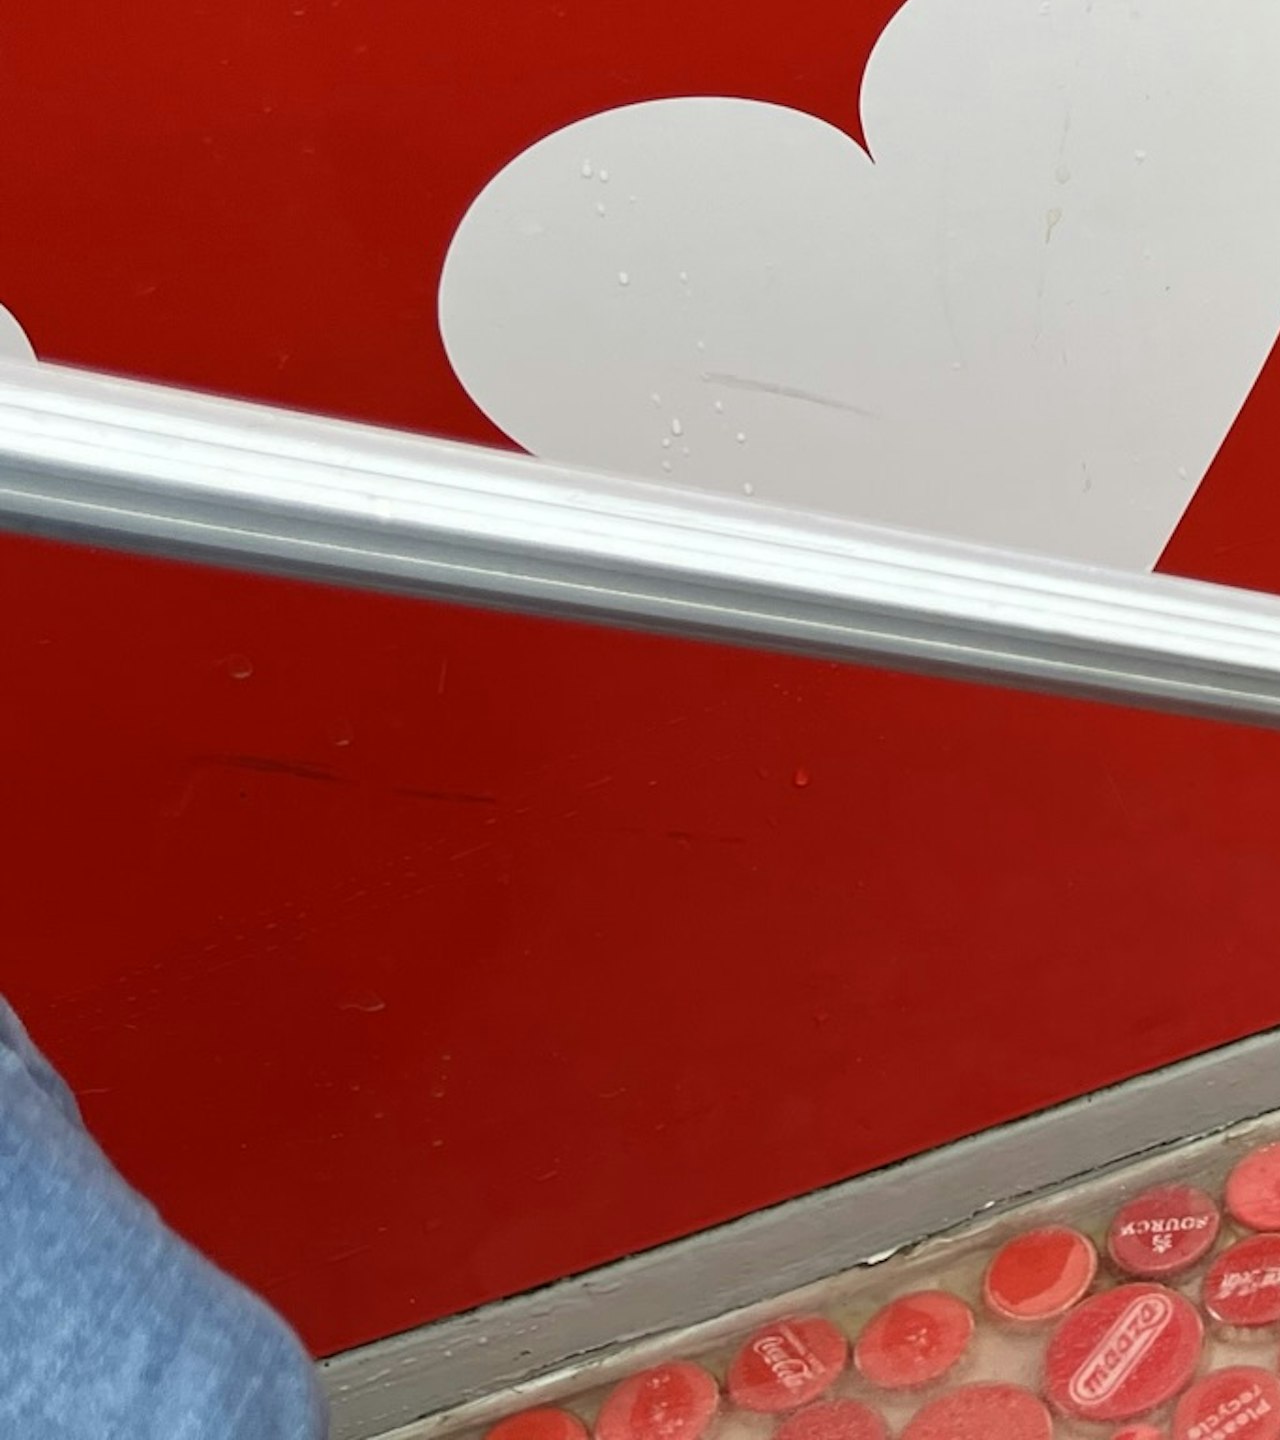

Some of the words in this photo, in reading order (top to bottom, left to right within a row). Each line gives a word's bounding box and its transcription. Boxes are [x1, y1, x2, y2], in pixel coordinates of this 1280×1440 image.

[1120, 1216, 1208, 1236] SOURCY
[1078, 1302, 1161, 1395] maaza
[1187, 1385, 1262, 1439] recycle
